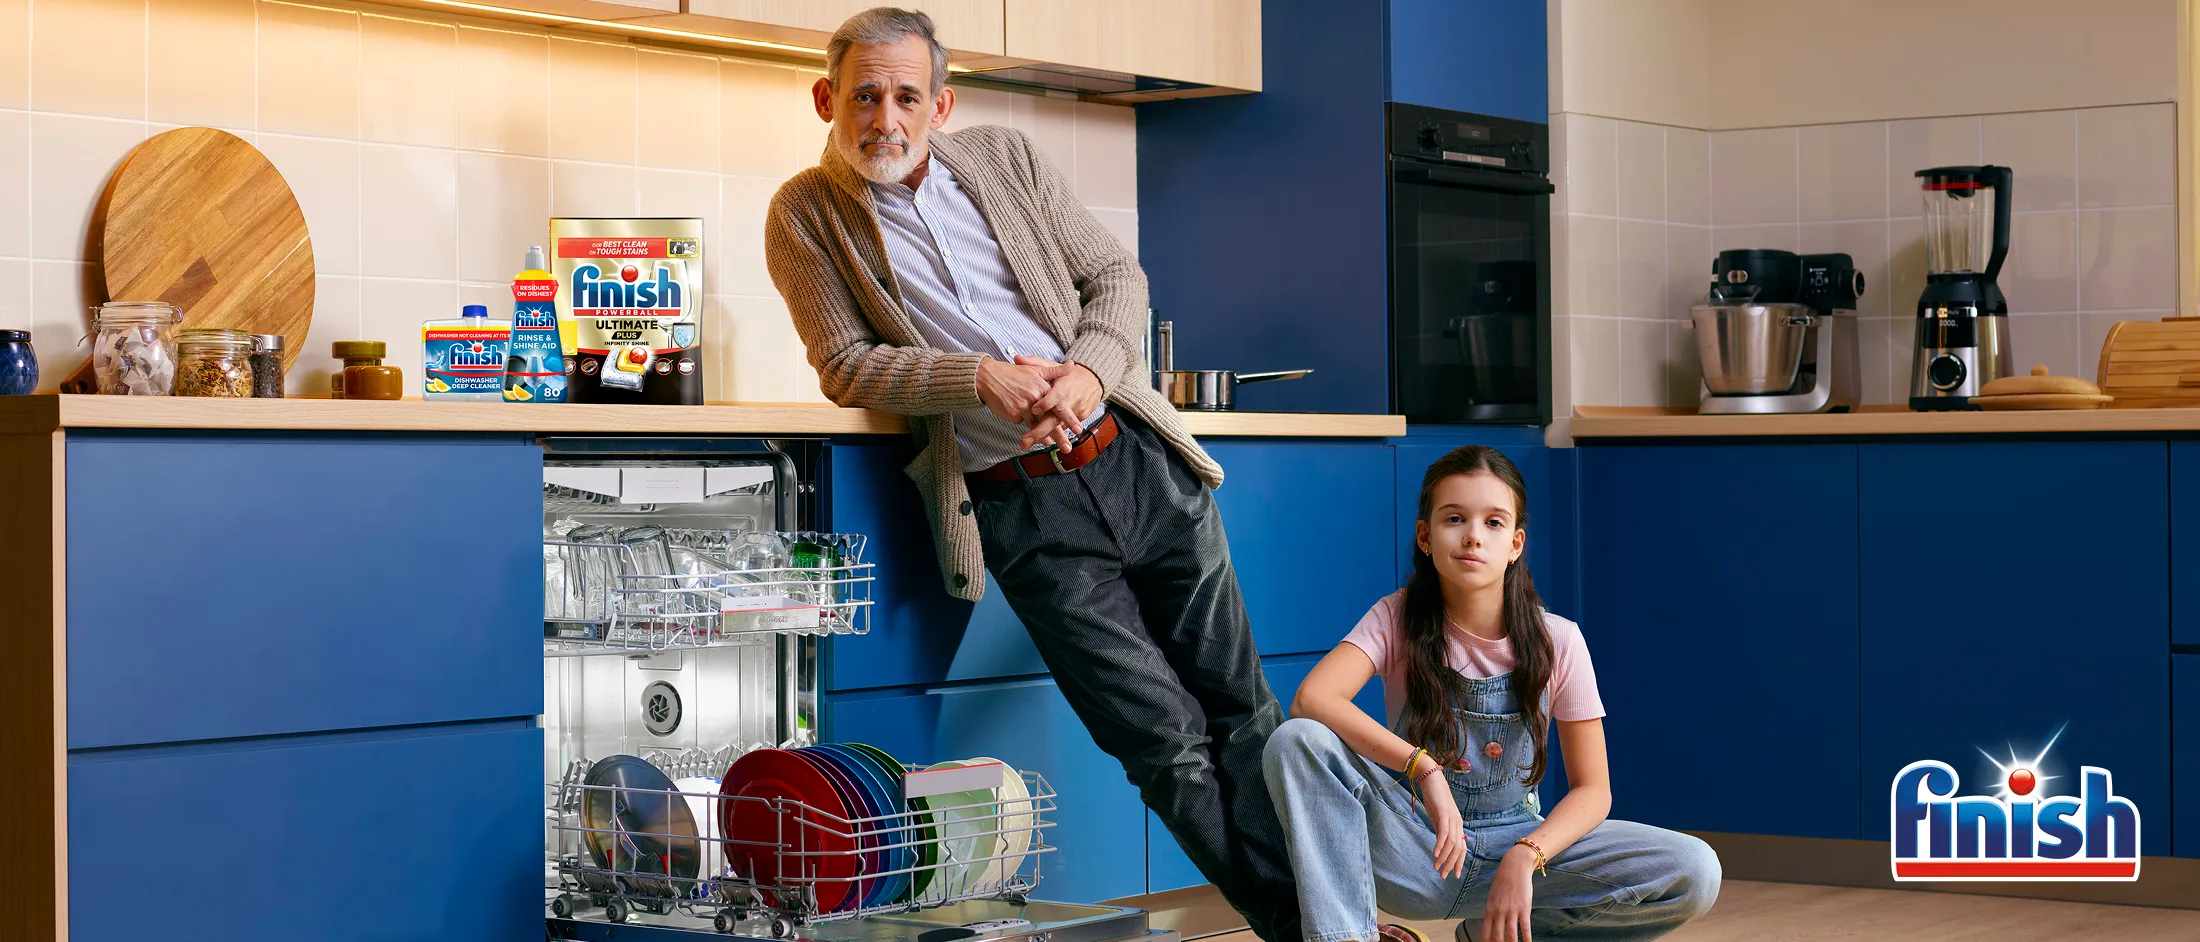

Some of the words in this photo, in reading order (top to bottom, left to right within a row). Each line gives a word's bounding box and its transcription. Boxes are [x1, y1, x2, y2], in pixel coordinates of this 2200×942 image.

[572, 264, 682, 308] finish
[515, 311, 555, 327] finish
[595, 320, 659, 330] ULTIMATE
[518, 334, 544, 342] RINSE
[545, 334, 552, 342] &
[513, 342, 540, 350] SHINE
[541, 342, 557, 350] AID
[450, 343, 503, 365] finish
[543, 387, 561, 397] 80
